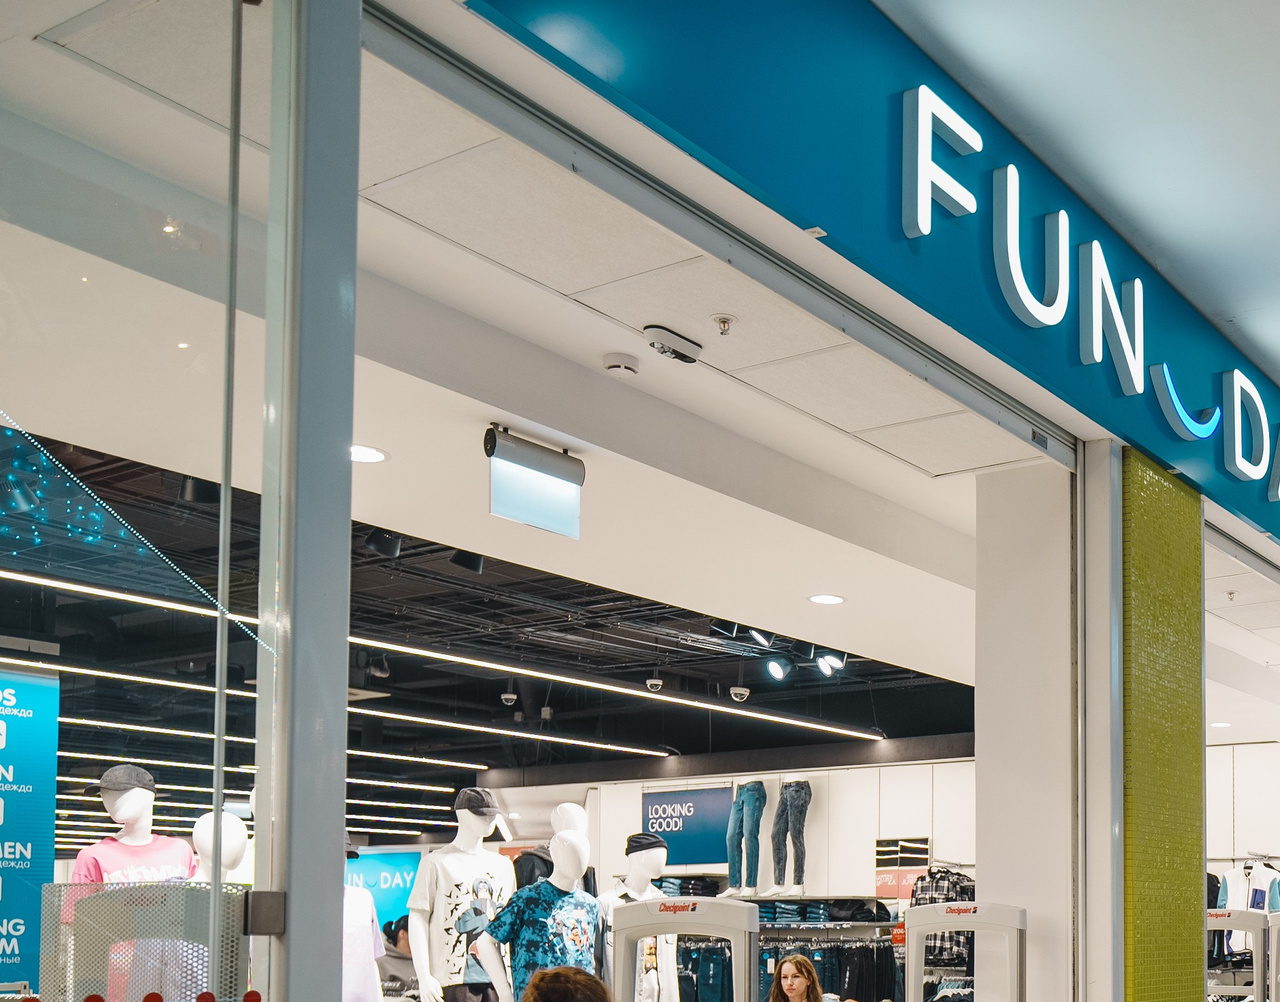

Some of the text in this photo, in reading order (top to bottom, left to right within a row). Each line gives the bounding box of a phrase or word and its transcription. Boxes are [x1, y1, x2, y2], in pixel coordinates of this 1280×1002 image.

[903, 84, 1145, 396] FUN
[648, 802, 694, 818] LOOKING
[648, 818, 683, 832] GOOD!
[380, 871, 414, 889] DAY
[659, 902, 690, 914] Checkpoint
[945, 906, 972, 915] Checkpoint
